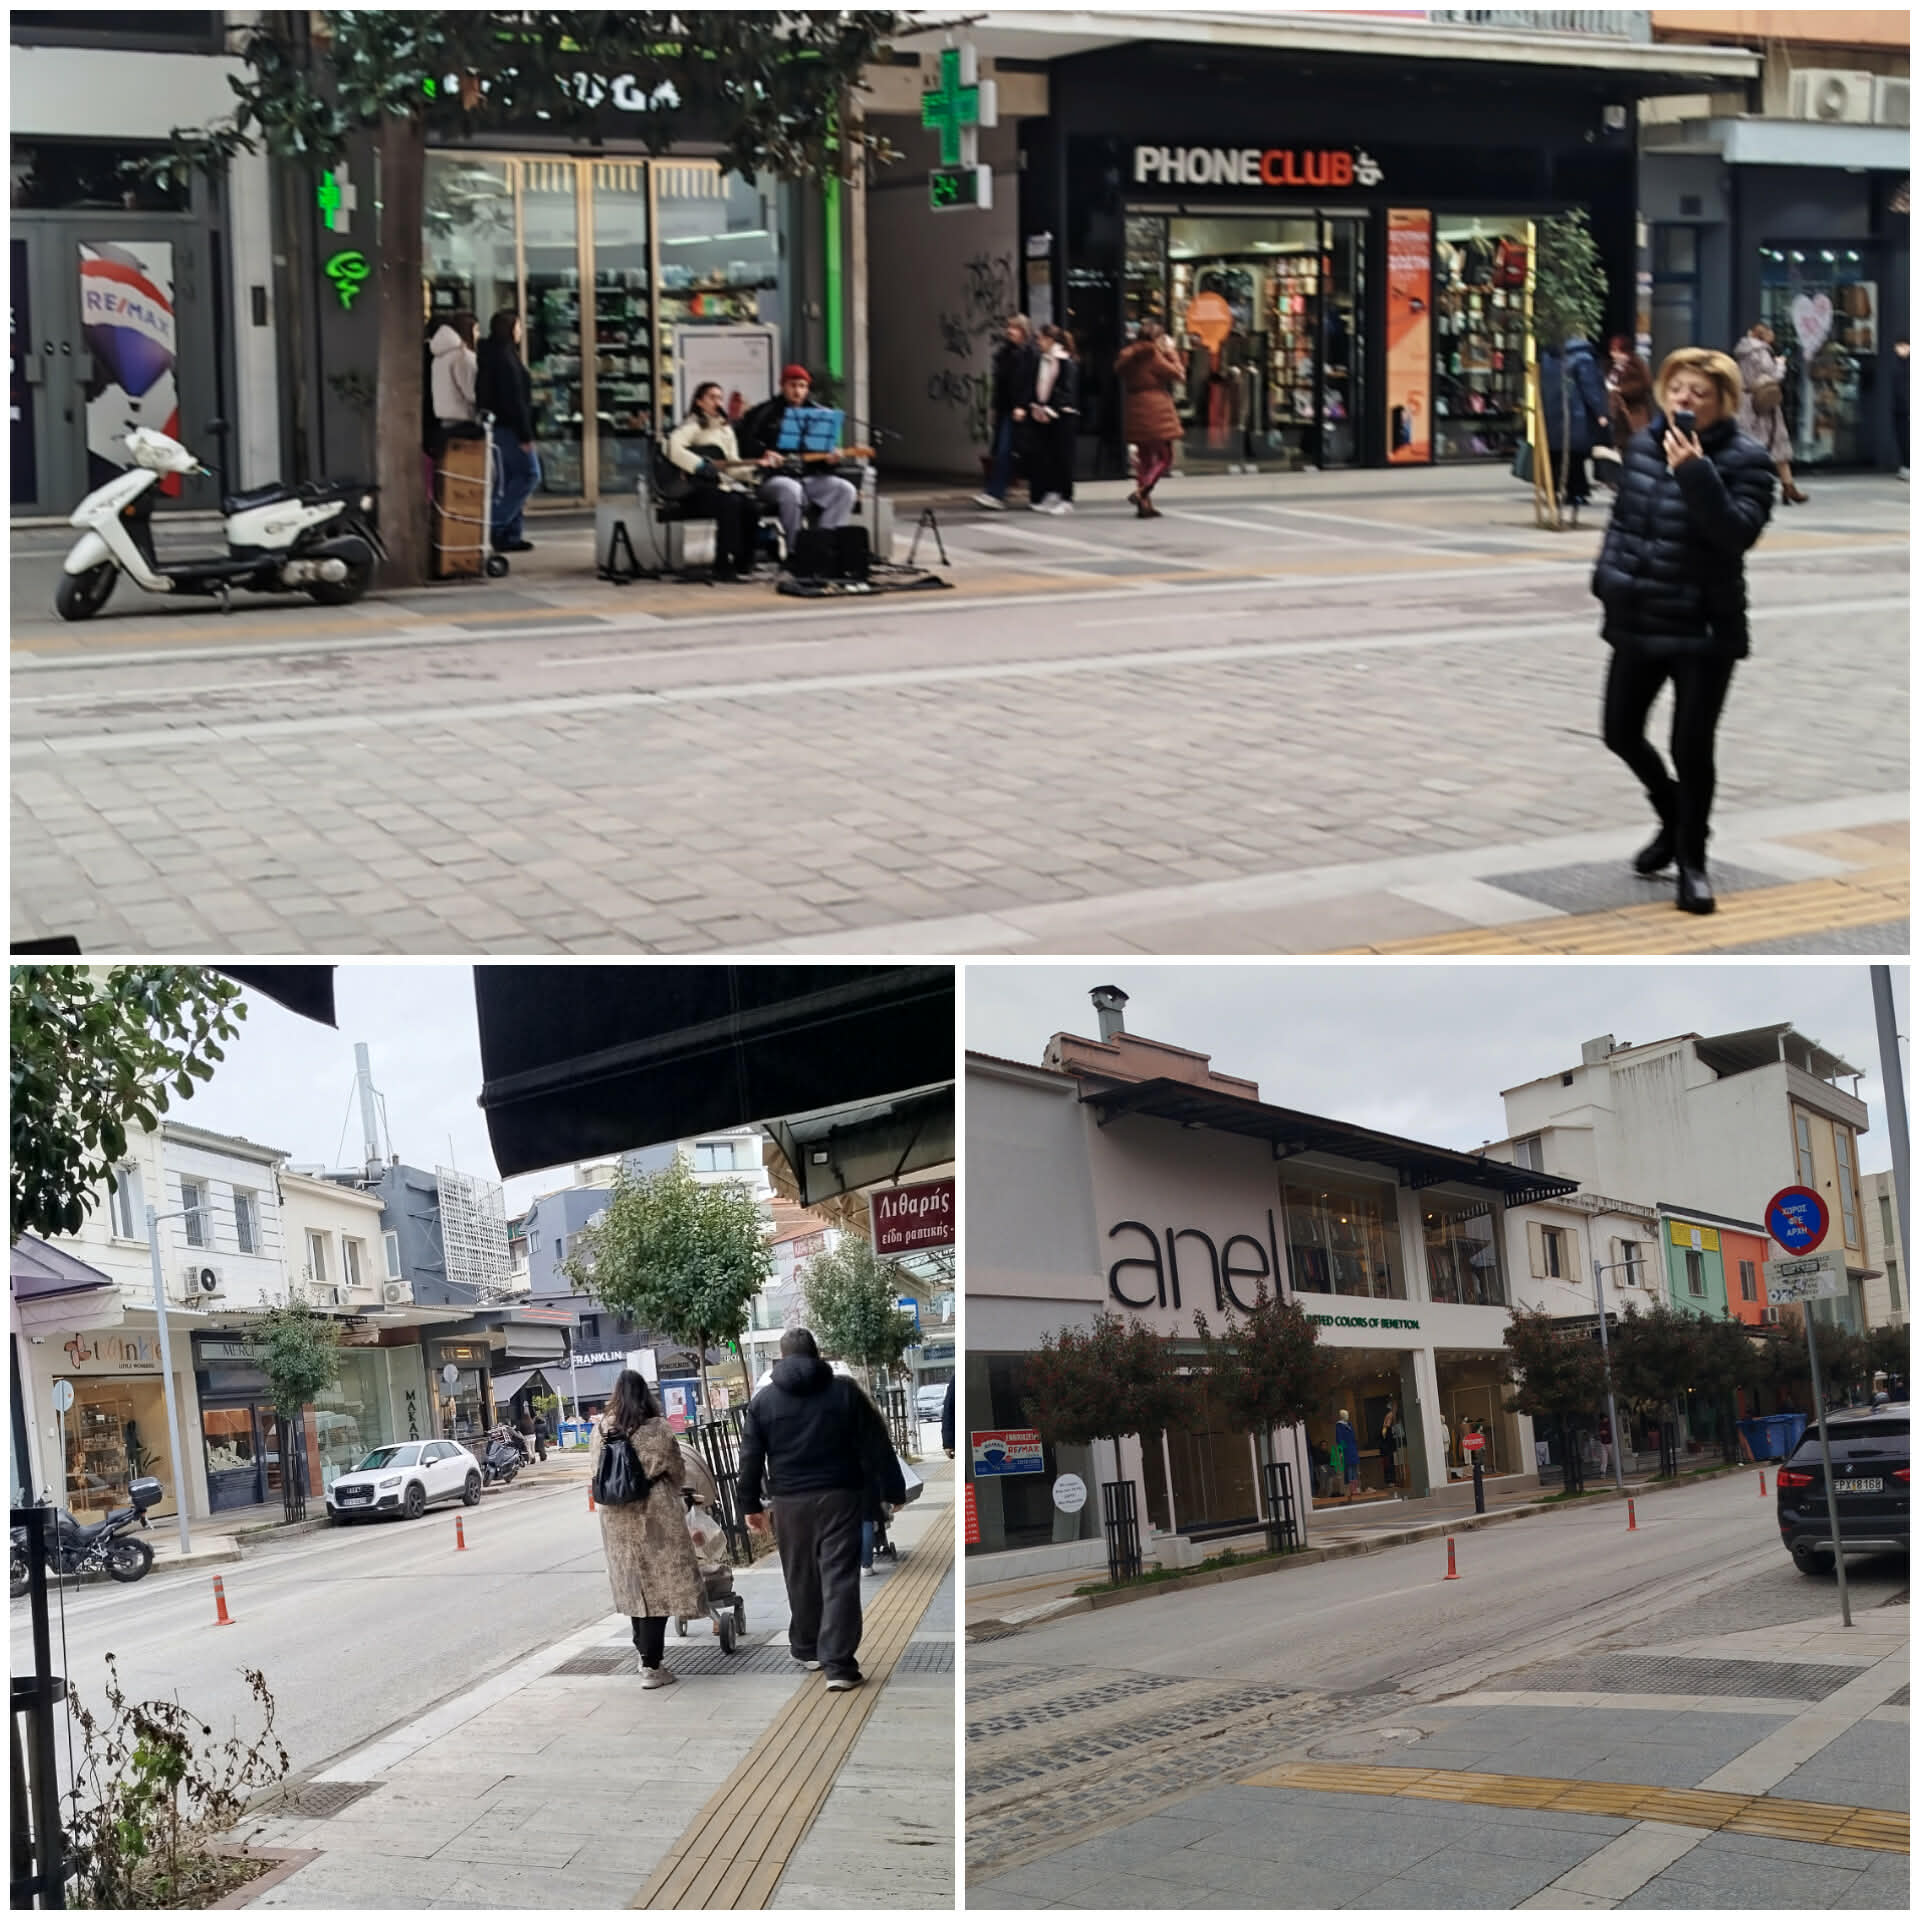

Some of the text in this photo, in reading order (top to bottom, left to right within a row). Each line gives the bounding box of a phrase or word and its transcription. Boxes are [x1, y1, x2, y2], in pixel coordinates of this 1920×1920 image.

[1134, 146, 1353, 187] PHONECLUB
[86, 290, 169, 335] RE/MAX
[880, 1187, 950, 1219] Λιθαρής
[882, 1221, 949, 1245] είδη ραπτικής
[1109, 1208, 1284, 1314] anel
[1335, 1316, 1368, 1328] COLORS
[1369, 1318, 1380, 1328] OF
[573, 1351, 622, 1364] FRANKLIN
[1007, 1445, 1040, 1454] RE/MAX
